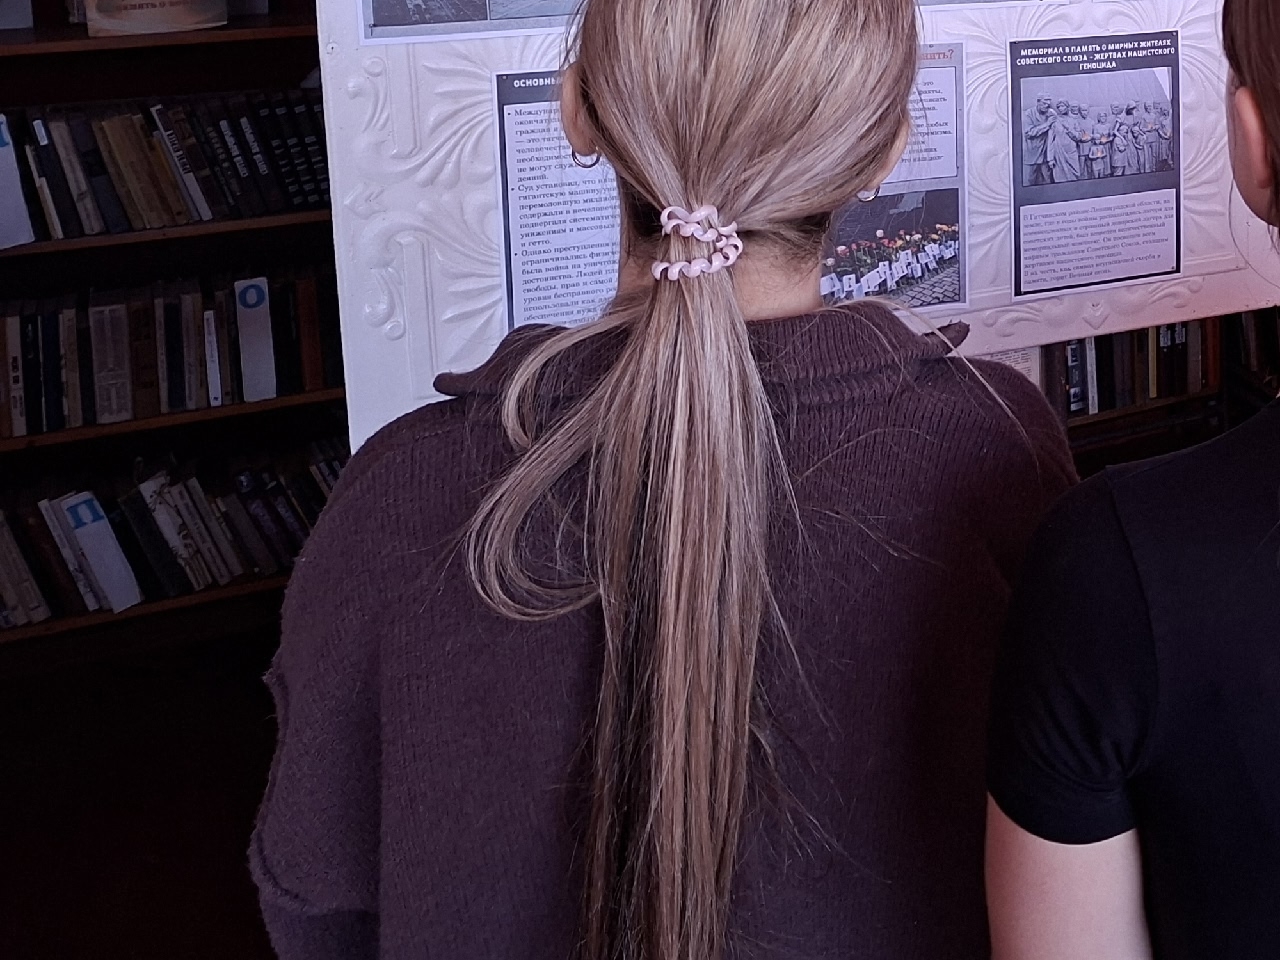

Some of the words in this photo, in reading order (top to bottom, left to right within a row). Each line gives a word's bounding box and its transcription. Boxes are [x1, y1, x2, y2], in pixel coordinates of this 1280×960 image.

[1020, 47, 1063, 56] МЕМОРИАЛ
[1071, 44, 1100, 53] ПАМЯТЬ
[1107, 42, 1138, 50] МИРНЫХ
[1139, 39, 1171, 48] ЖИТЕЛЯХ
[1016, 57, 1060, 66] СОВЕТСКОГО
[1062, 55, 1087, 63] СОЮЗА
[1093, 52, 1126, 61] ЖЕРТВАХ
[1127, 48, 1175, 58] НАЦИСТСКОГО
[1079, 62, 1116, 71] ГЕНОЦИДА
[65, 498, 105, 530] П
